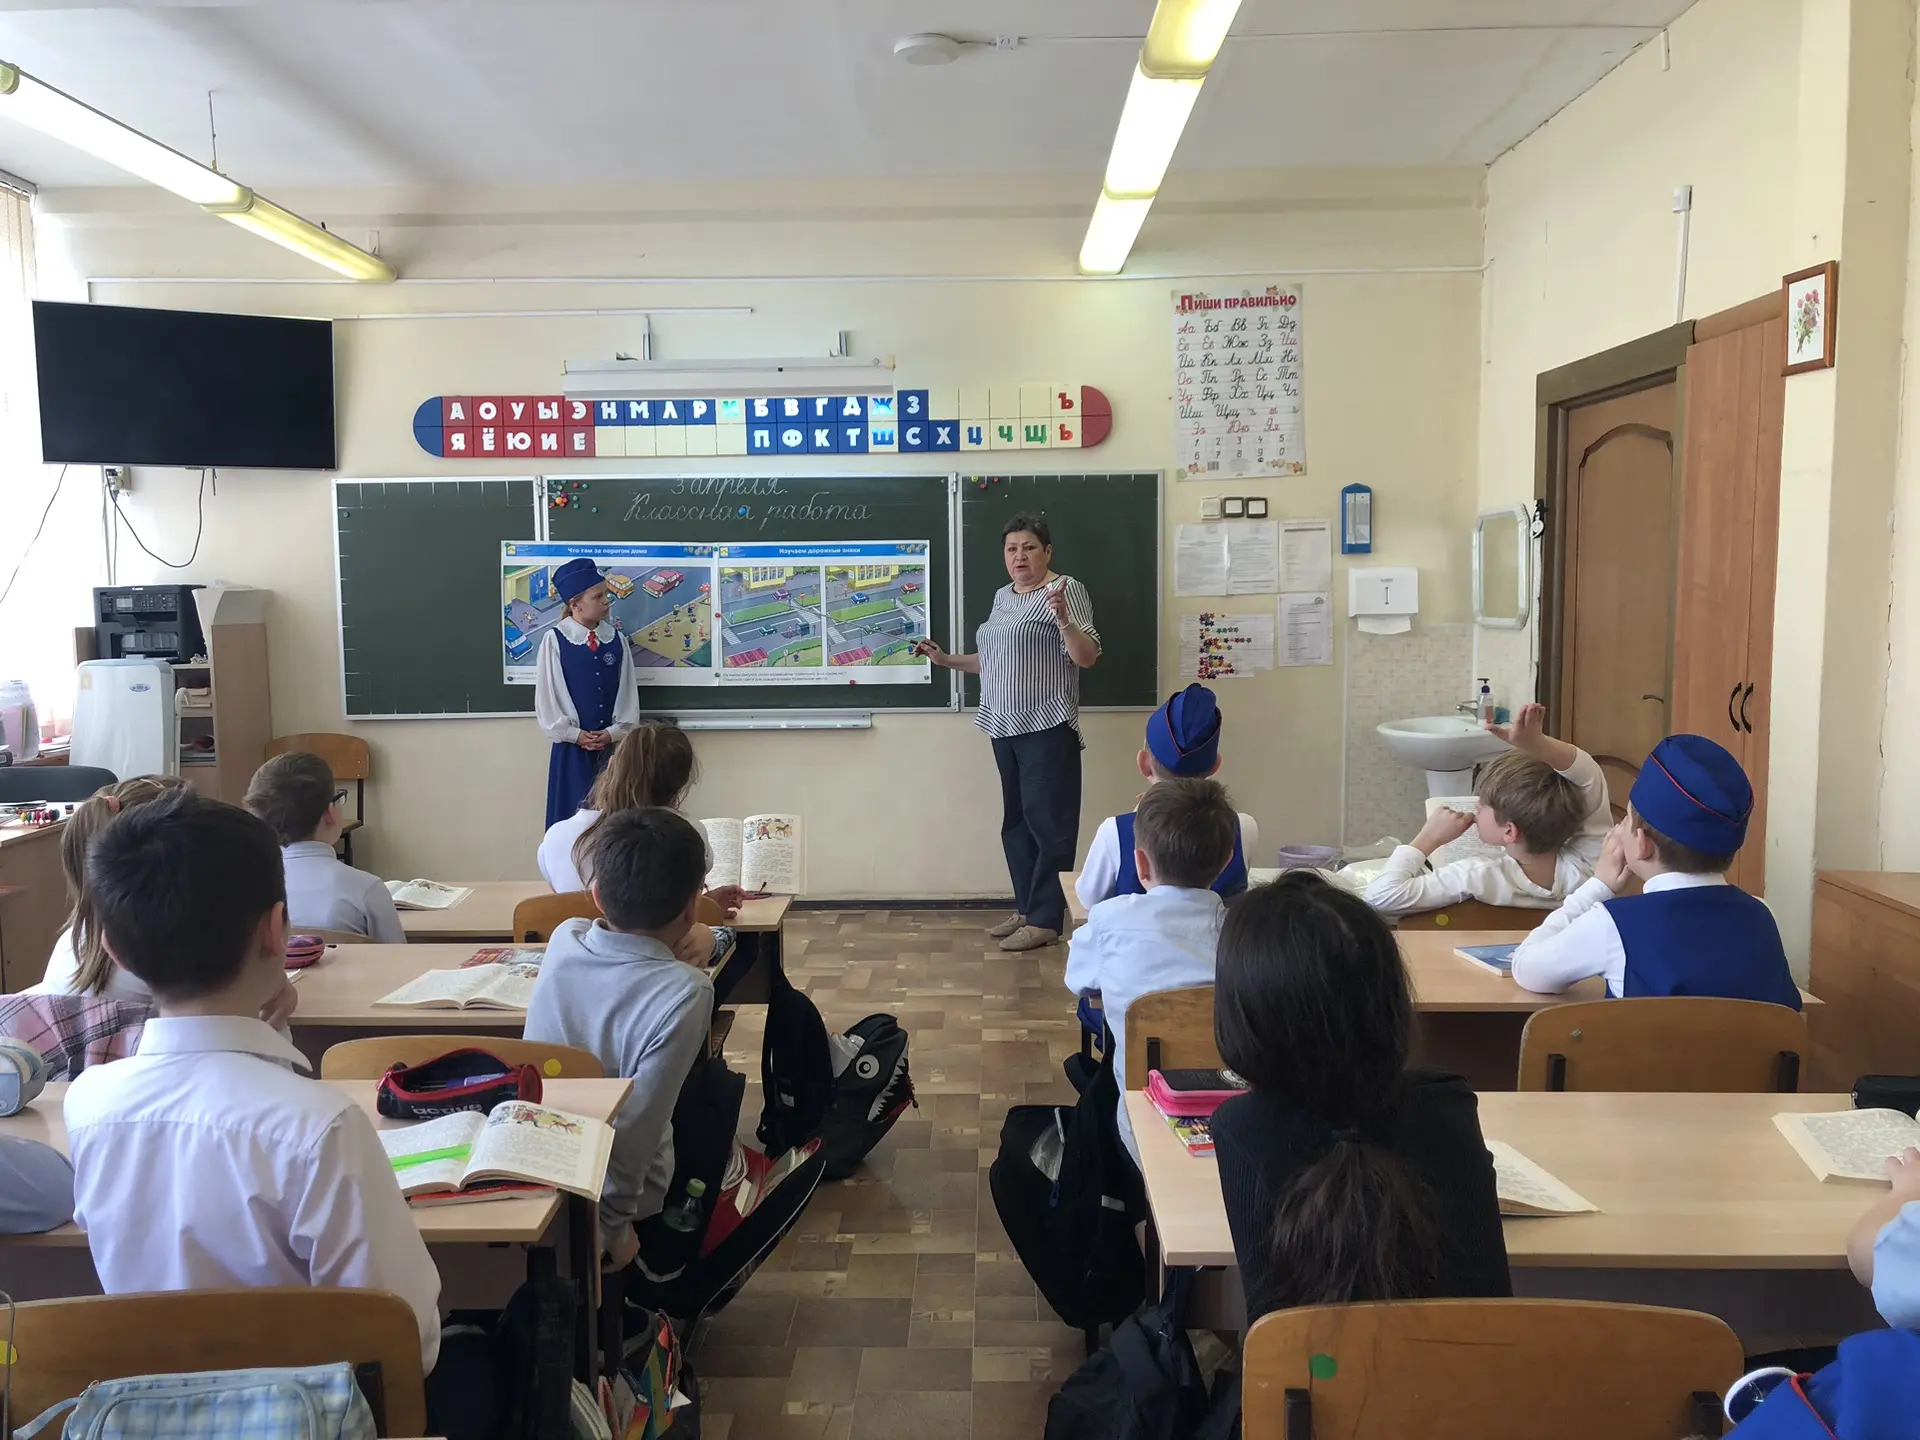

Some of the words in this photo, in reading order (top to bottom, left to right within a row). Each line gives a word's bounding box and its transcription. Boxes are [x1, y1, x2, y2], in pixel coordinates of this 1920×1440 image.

[450, 402, 465, 420] А
[479, 401, 498, 420] О
[511, 402, 524, 420] У
[538, 401, 558, 420] Ы
[572, 401, 587, 420] Э
[601, 401, 617, 420] Н
[629, 401, 649, 419] М
[662, 400, 678, 419] Л
[692, 400, 707, 419] Р
[753, 398, 769, 417] Б
[784, 397, 798, 417] В
[815, 397, 829, 417] Г
[842, 396, 862, 416] Д
[872, 397, 894, 416] Ж
[907, 395, 920, 413] З
[1058, 392, 1075, 410] Ъ
[450, 432, 465, 451] Я
[482, 428, 496, 451] Ё
[506, 432, 531, 450] Ю
[541, 432, 557, 450] И
[573, 432, 586, 451] Е
[754, 429, 771, 447] П
[782, 429, 802, 448] Ф
[814, 428, 830, 447] К
[846, 428, 861, 447] Т
[872, 427, 894, 446] Ш
[905, 427, 921, 445] С
[936, 427, 951, 445] Х
[967, 426, 983, 446] Ц
[998, 425, 1014, 443] Ч
[1024, 424, 1048, 444] Щ
[1059, 423, 1074, 442] Ь
[623, 491, 755, 521] Классная
[759, 491, 874, 531] работа
